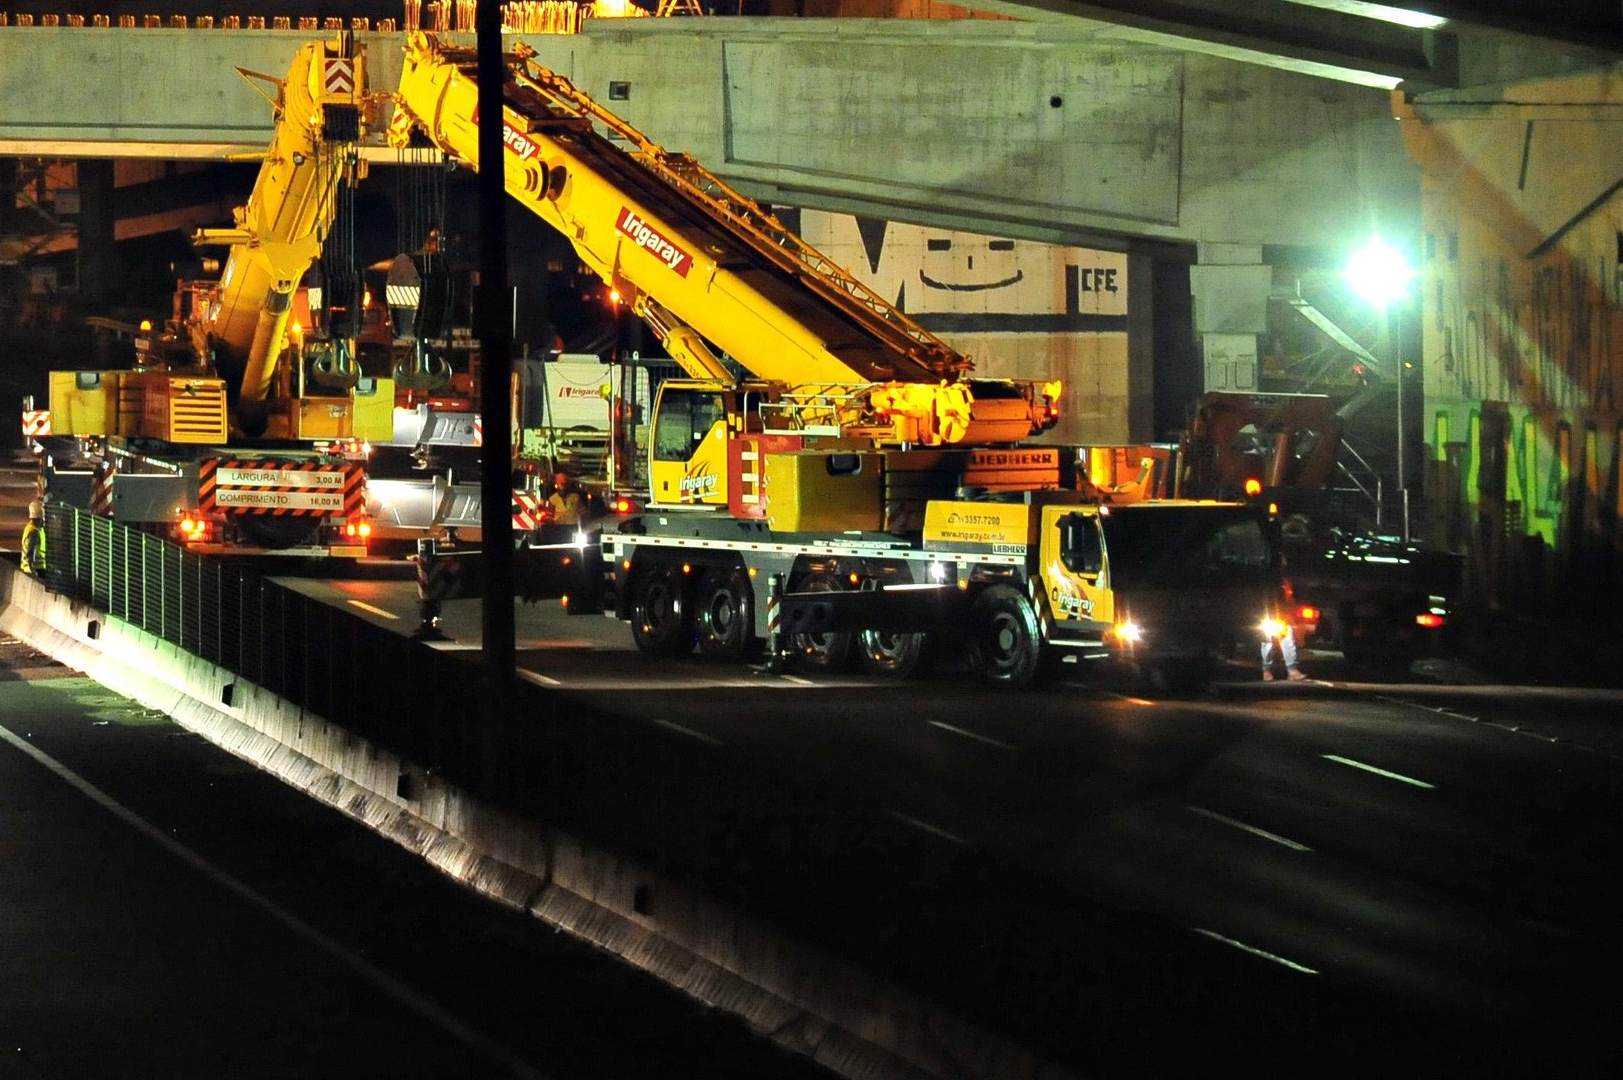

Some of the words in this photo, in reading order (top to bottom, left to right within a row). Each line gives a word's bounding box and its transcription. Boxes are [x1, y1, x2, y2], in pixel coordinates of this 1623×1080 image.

[622, 212, 685, 269] Irigaray
[572, 387, 601, 396] Irigara
[972, 453, 1053, 465] LIEBHERR
[231, 472, 276, 482] LARGURA
[316, 476, 332, 485] 3,00
[334, 477, 342, 485] M
[679, 473, 718, 491] Irigaray
[219, 494, 289, 505] COMPRIMENTO
[310, 497, 331, 506] 16,00
[332, 498, 340, 506] M
[993, 545, 1027, 554] LIEBHERR
[1058, 591, 1095, 613] Irigaray
